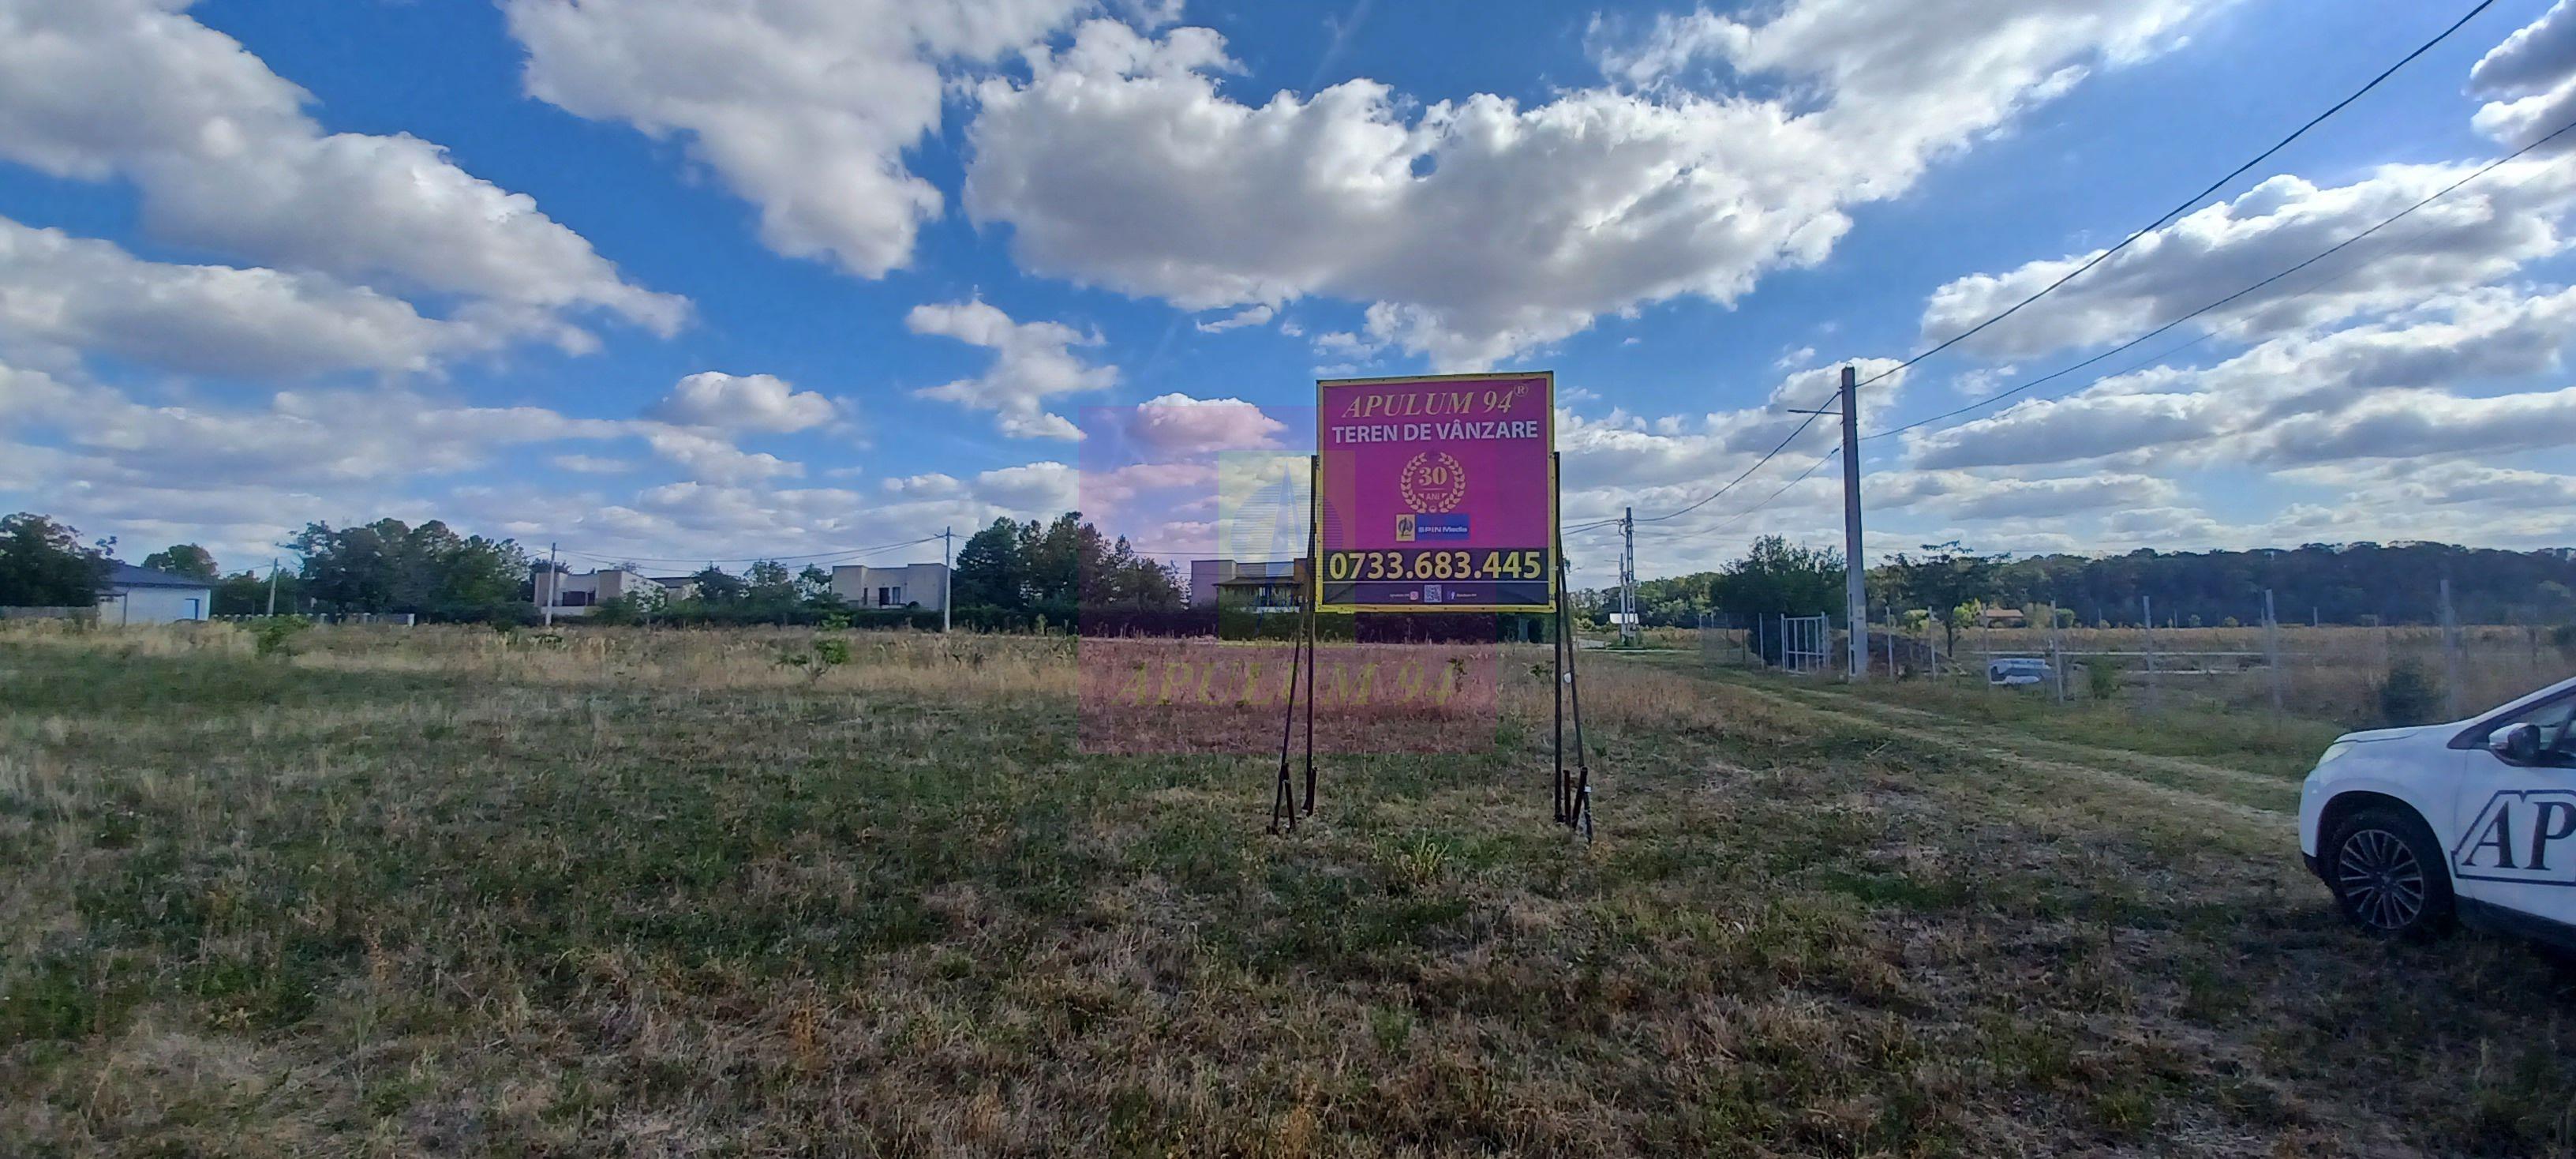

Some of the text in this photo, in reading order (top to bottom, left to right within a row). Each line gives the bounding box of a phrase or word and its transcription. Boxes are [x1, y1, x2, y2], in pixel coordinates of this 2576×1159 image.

[1342, 391, 1474, 418] APULUM
[1331, 419, 1538, 444] TEREN DE VÂNZARE
[1418, 467, 1447, 486] 30
[1329, 551, 1541, 580] 0733.683.445
